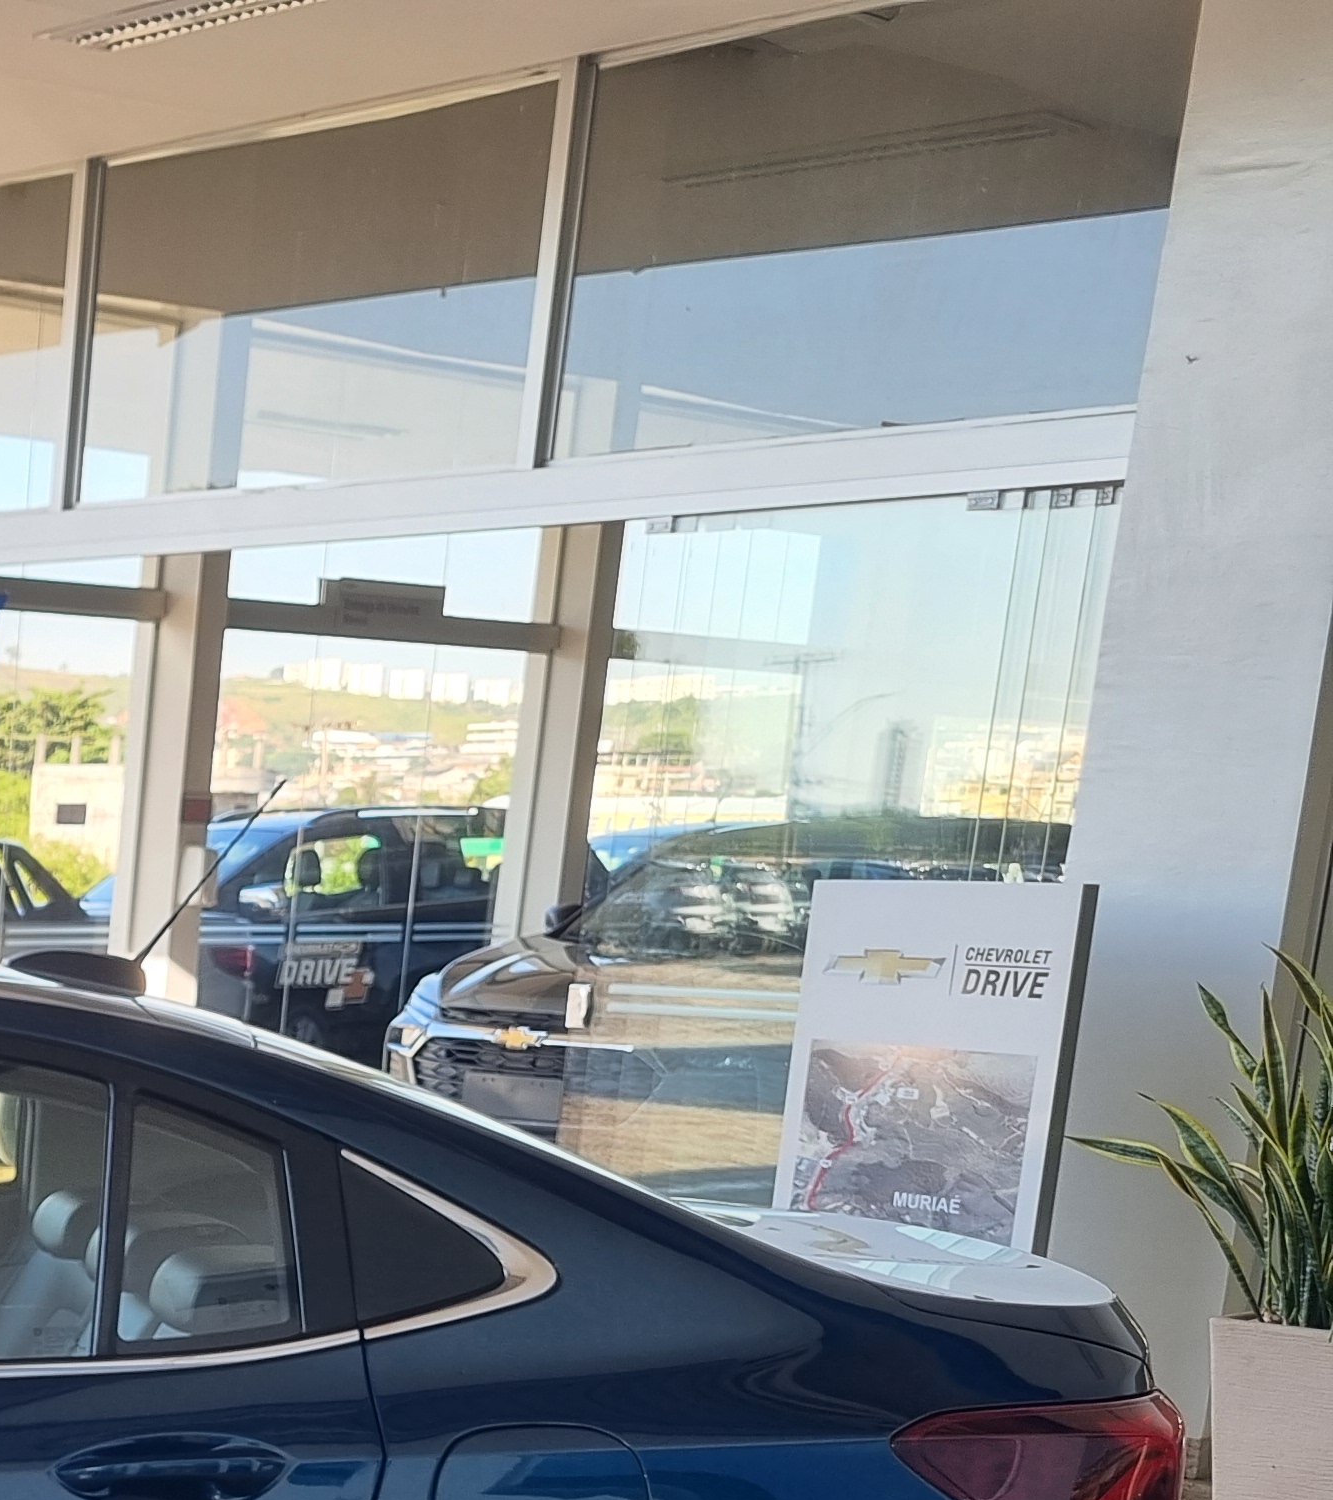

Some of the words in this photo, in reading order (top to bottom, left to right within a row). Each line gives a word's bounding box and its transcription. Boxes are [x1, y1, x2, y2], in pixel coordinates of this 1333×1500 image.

[965, 946, 1052, 964] CHEVROLET
[278, 958, 358, 986] DRIVE
[961, 968, 1049, 999] DRIVE
[893, 1191, 961, 1215] MURIAÉ
